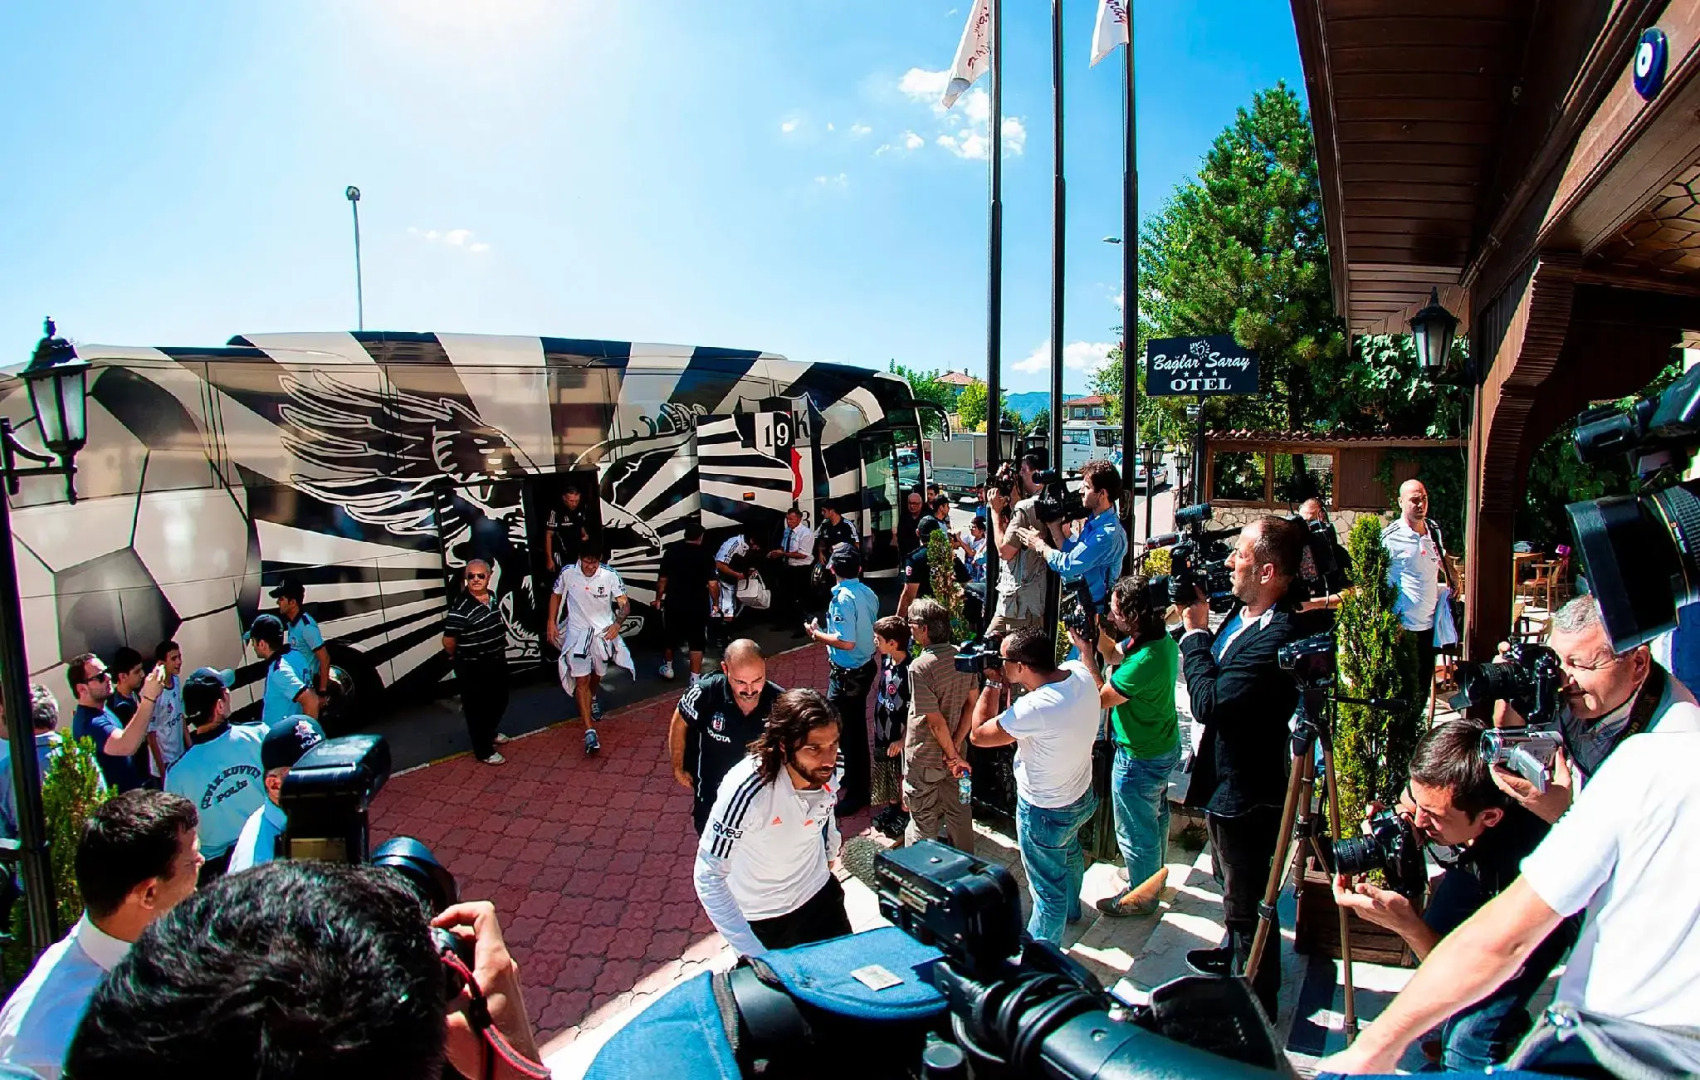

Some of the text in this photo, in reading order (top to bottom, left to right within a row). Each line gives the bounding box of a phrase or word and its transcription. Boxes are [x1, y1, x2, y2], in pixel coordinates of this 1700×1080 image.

[1153, 352, 1251, 375] Bağlar Saray
[1170, 377, 1232, 391] OTEL
[765, 422, 789, 447] 19
[712, 820, 743, 839] avea
